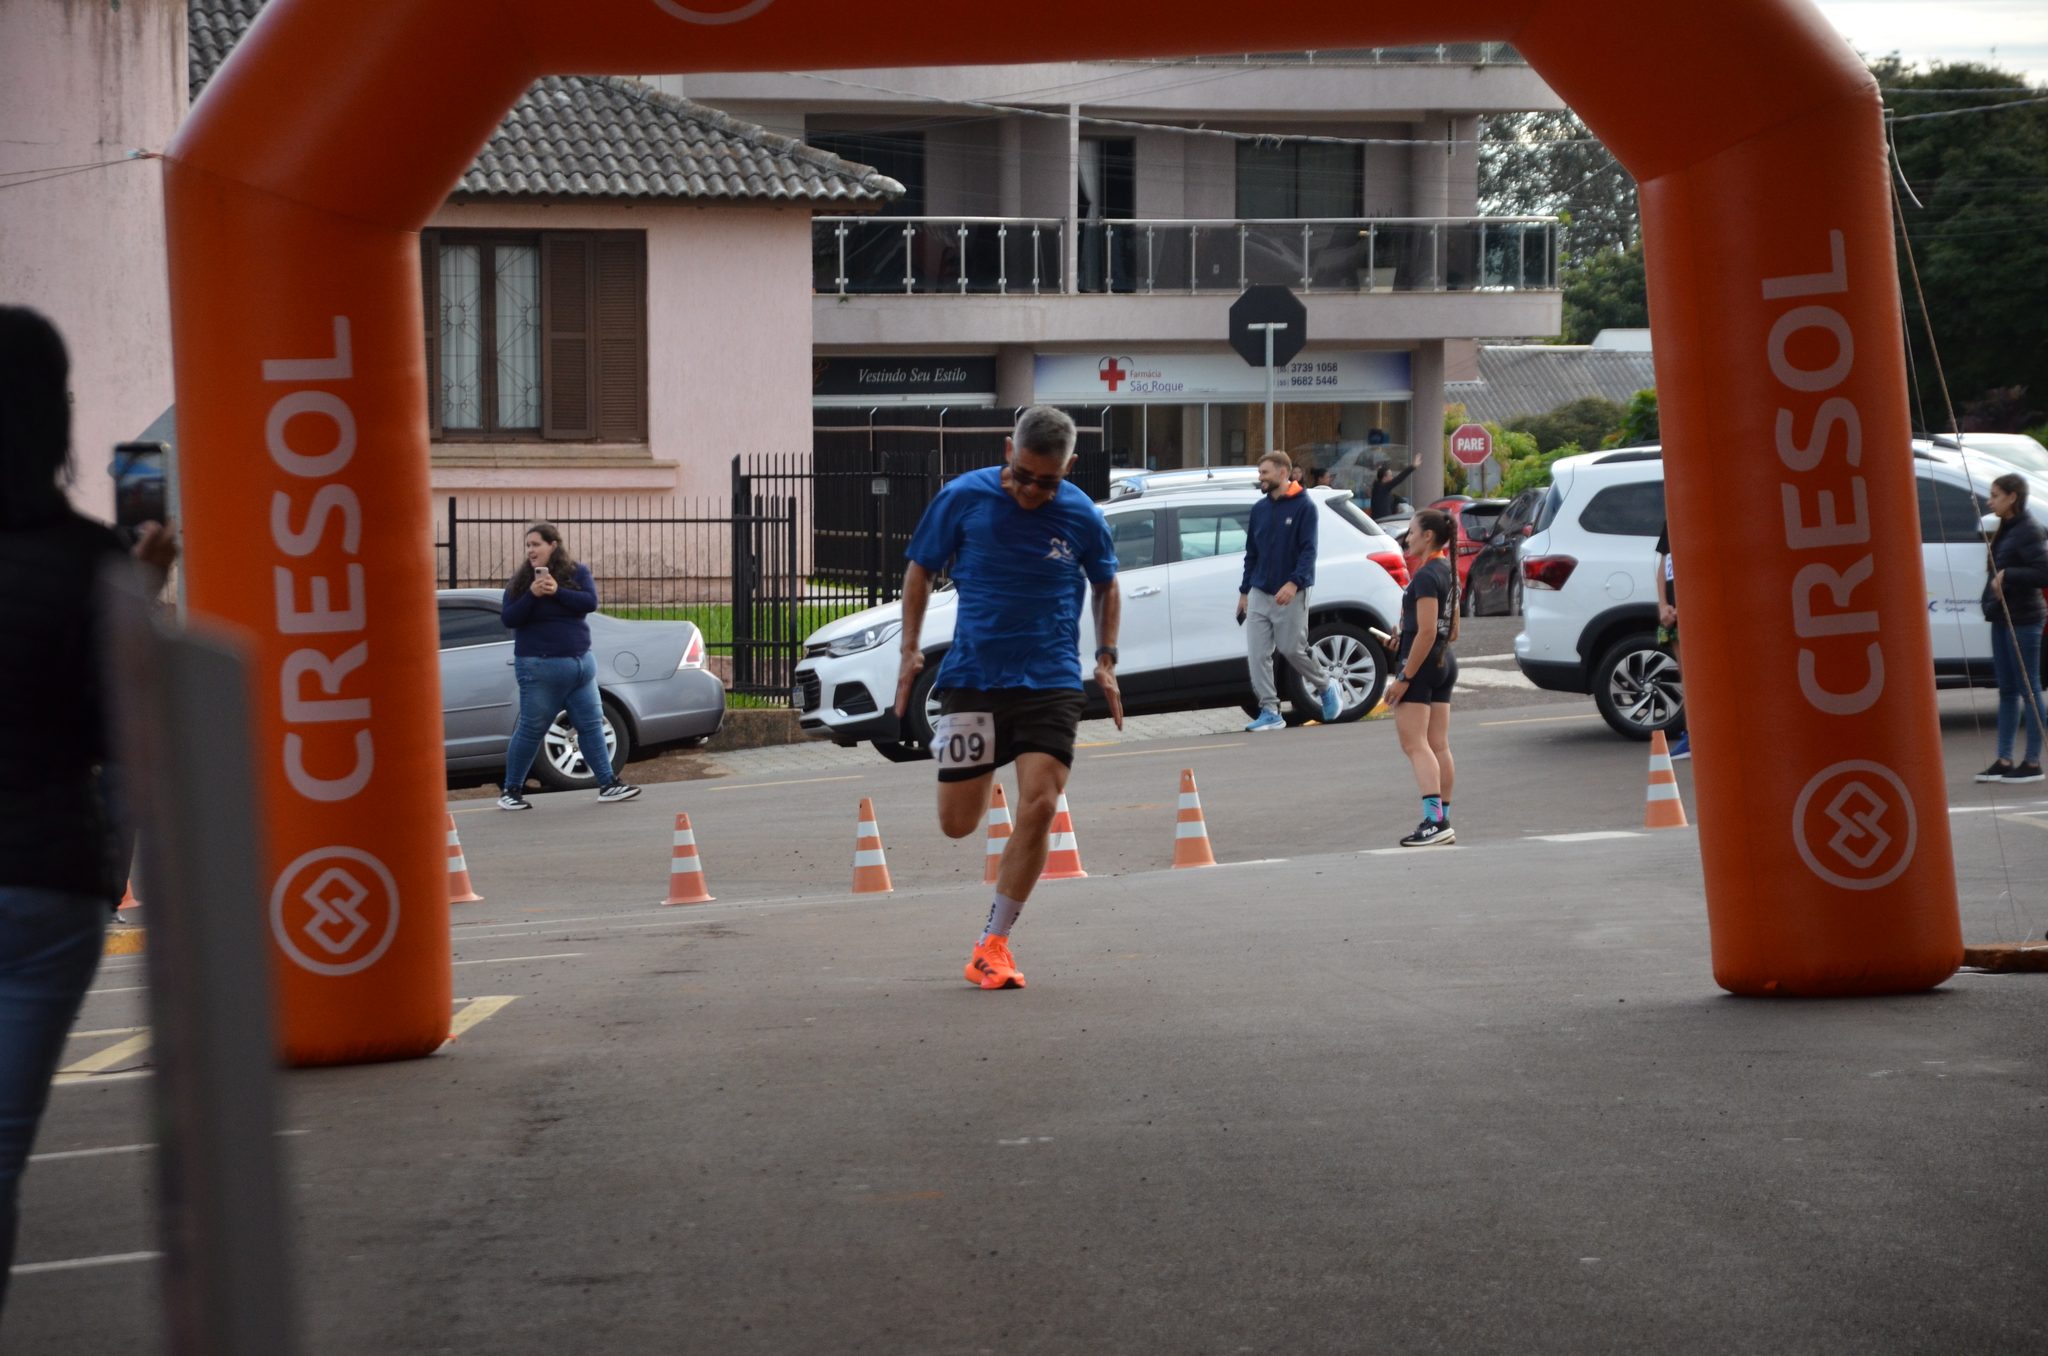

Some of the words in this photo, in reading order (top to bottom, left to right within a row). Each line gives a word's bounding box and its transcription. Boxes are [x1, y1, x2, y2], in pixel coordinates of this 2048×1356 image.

[1130, 368, 1162, 378] Farmácia
[1291, 362, 1313, 372] 3739
[1316, 362, 1338, 372] 1058
[858, 368, 907, 383] Vestindo
[909, 368, 931, 382] Seu
[934, 367, 967, 382] Estilo
[1291, 376, 1313, 386] 9682
[1315, 375, 1338, 386] 5446
[1130, 380, 1149, 392] São
[1151, 380, 1184, 393] Roque
[1457, 438, 1485, 451] PARE
[1761, 228, 1885, 716] CRESOL
[262, 315, 375, 802] CRESOL
